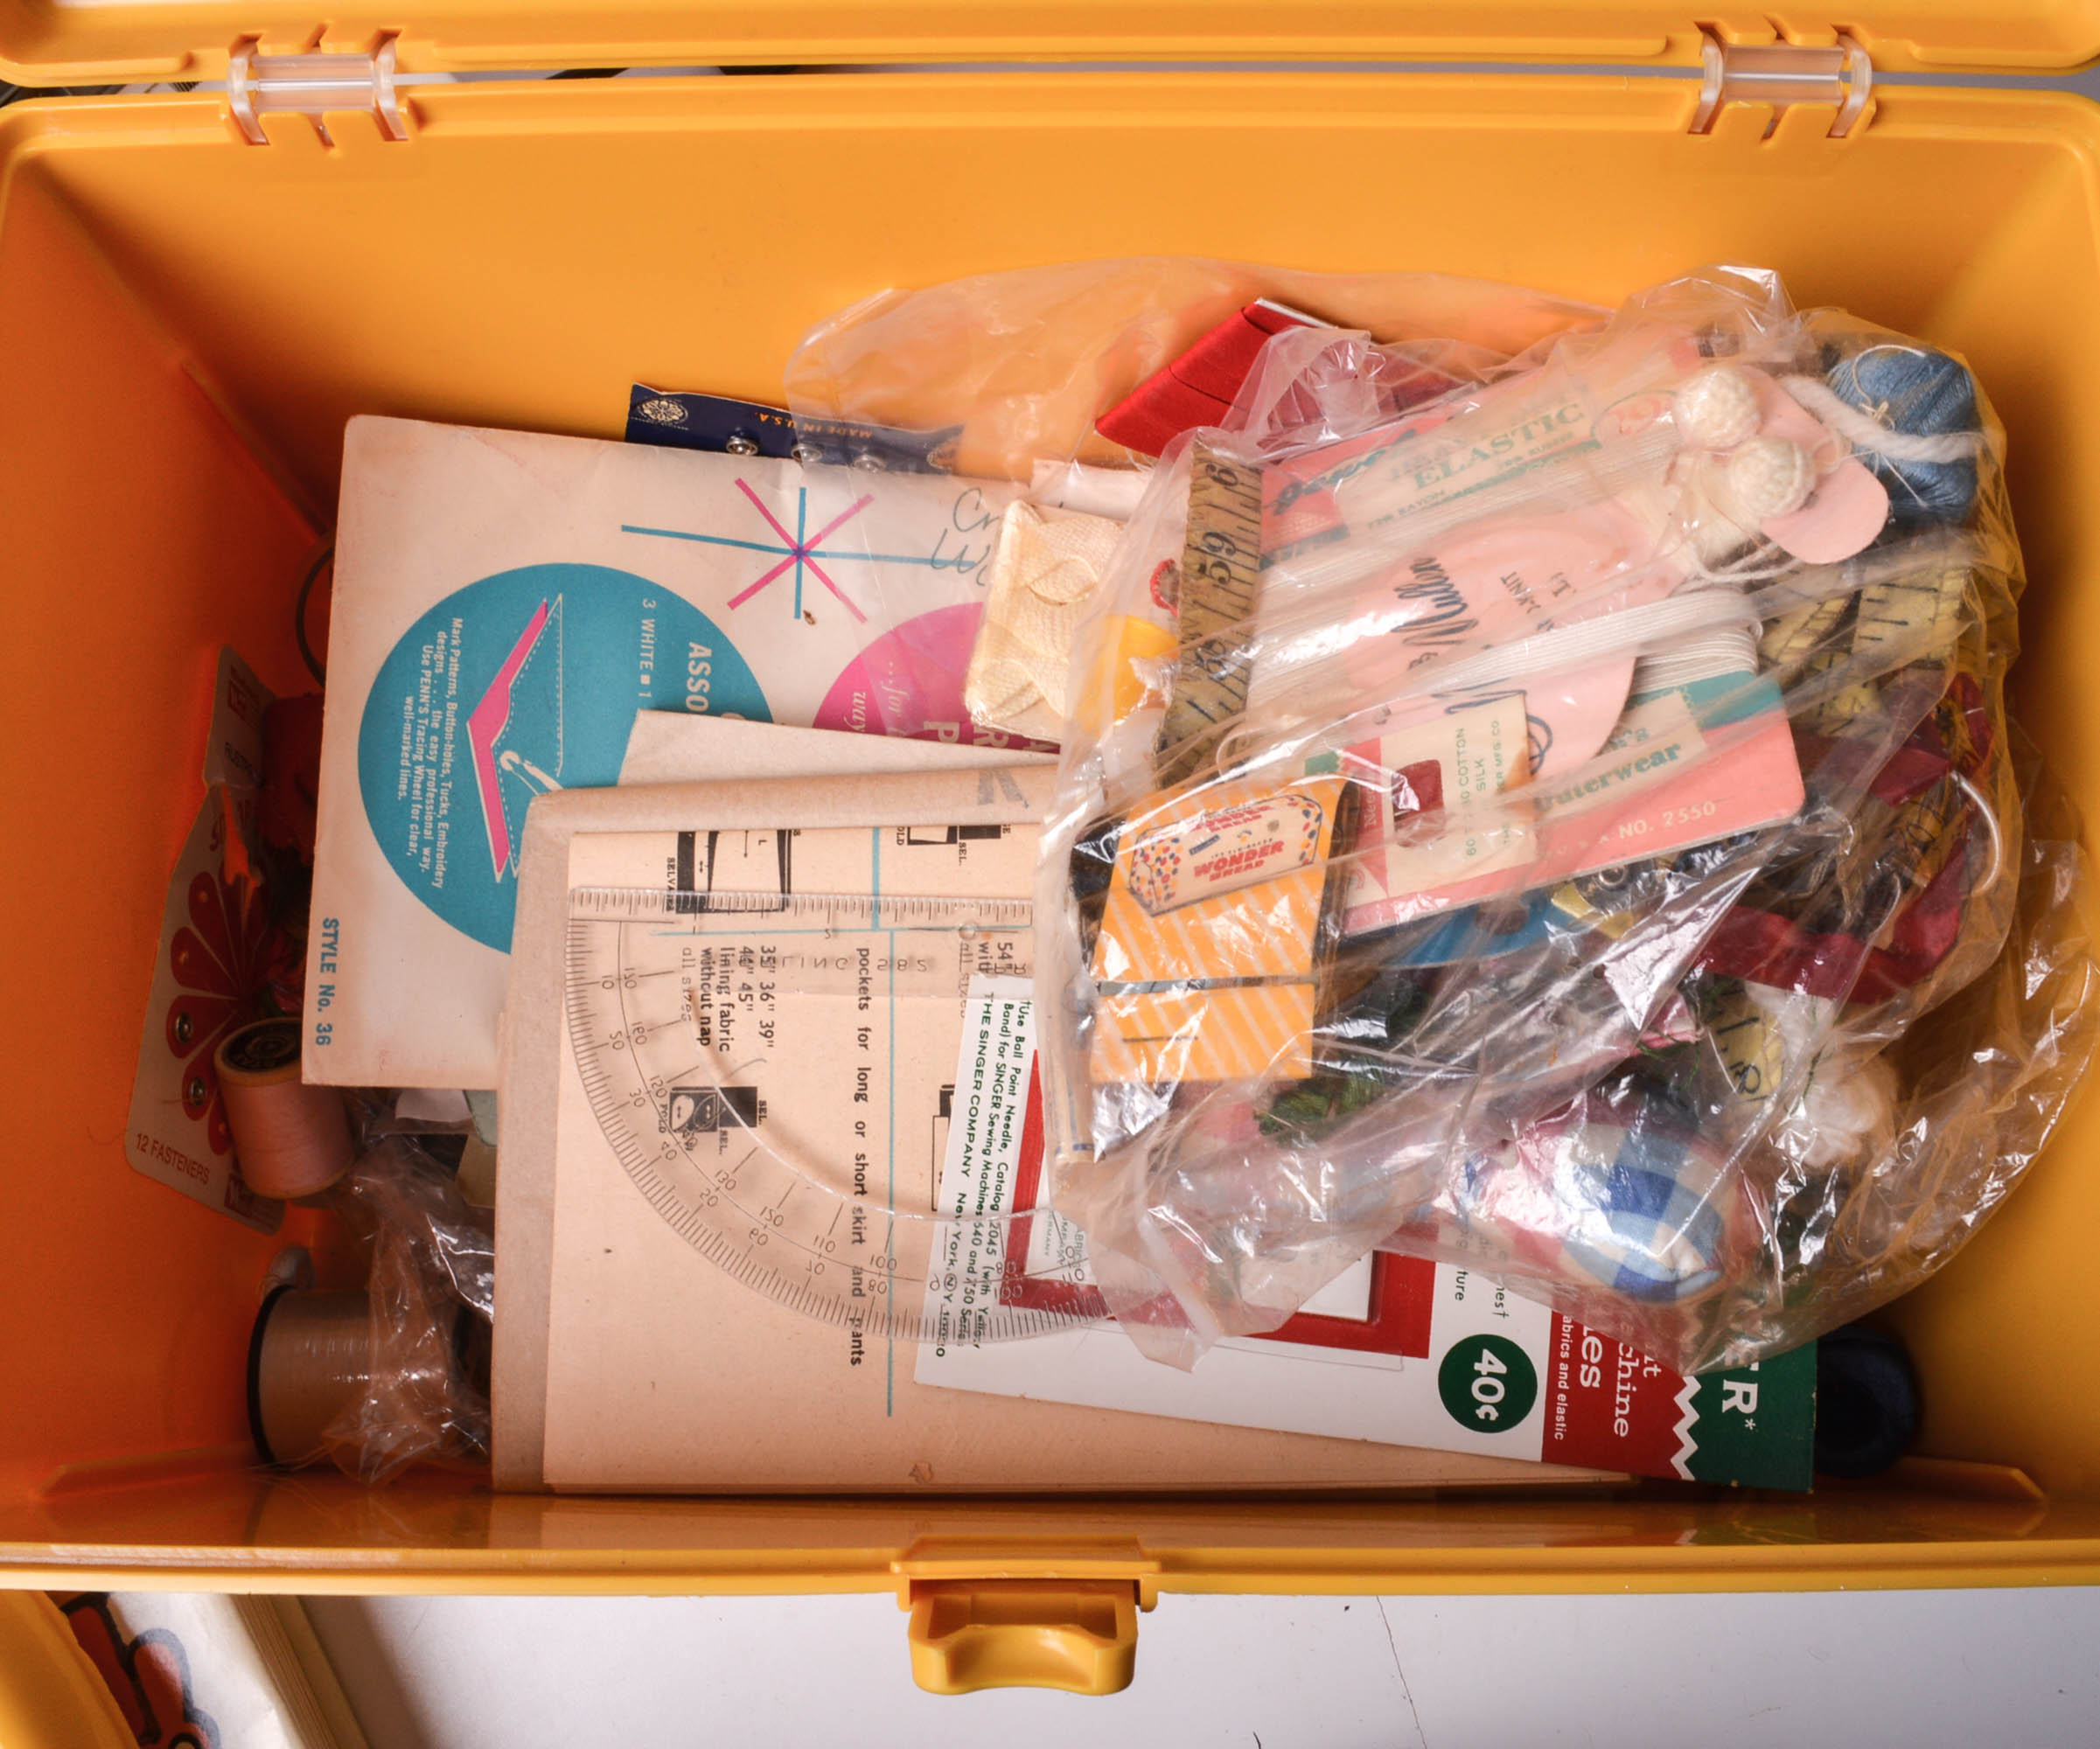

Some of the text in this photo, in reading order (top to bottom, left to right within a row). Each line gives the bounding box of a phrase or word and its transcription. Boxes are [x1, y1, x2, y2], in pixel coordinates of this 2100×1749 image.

[802, 422, 822, 436] IN
[827, 424, 873, 439] MADE
[1411, 401, 1587, 489] ELASTIC
[1197, 531, 1237, 587] 59
[641, 598, 656, 609] 3
[638, 618, 656, 671] WHITE
[686, 642, 713, 713] ASSO
[397, 696, 415, 801] well-marked lines.
[406, 645, 433, 857] Use PENN'S Tracing Wheel for clear,
[420, 631, 448, 874] designs the easy professional way.
[432, 617, 464, 889] Mark Patterns, Button-holes, Tucks, Embroidery
[1455, 727, 1471, 787] COTTON
[1475, 756, 1487, 792] SILK
[897, 826, 906, 847] OLD
[1618, 817, 1656, 840] NO.
[1662, 799, 1717, 829] 2550
[1193, 840, 1285, 878] WONDER
[666, 857, 676, 912] SELVAES
[681, 946, 696, 969] all
[315, 917, 339, 1046] STYLE No. 36
[696, 946, 715, 1046] without nap
[718, 947, 735, 1052] lining fabric
[738, 981, 754, 1011] 45"
[759, 981, 776, 1012] 36"
[855, 947, 873, 1012] pockets
[980, 992, 995, 1026] THE
[999, 1003, 1015, 1038] Band)
[758, 1020, 775, 1049] 39"
[856, 1027, 872, 1051] for
[997, 1041, 1009, 1059] for
[1013, 1035, 1026, 1059] Ball
[972, 1028, 990, 1091] SINGER
[854, 1067, 872, 1103] long
[990, 1063, 1007, 1110] SINGER
[1007, 1067, 1022, 1097] Point
[758, 1099, 767, 1125] SEL.
[855, 1120, 867, 1138] or
[997, 1104, 1015, 1153] Needle,
[960, 1094, 981, 1178] COMPANY
[981, 1112, 1000, 1156] Sewing
[136, 1132, 211, 1186] 12 FASTENERS
[854, 1152, 869, 1196] short
[974, 1160, 995, 1216] Machines
[989, 1161, 1008, 1212] Catalog
[851, 1207, 867, 1246] skirt
[985, 1222, 1001, 1257] 2045
[851, 1266, 867, 1298] and
[966, 1250, 980, 1274] and
[980, 1265, 995, 1295] (with
[1470, 1348, 1508, 1421] 40¢
[1557, 1362, 1572, 1389] and
[1612, 1341, 1640, 1438] chine
[1552, 1393, 1571, 1441] elastic
